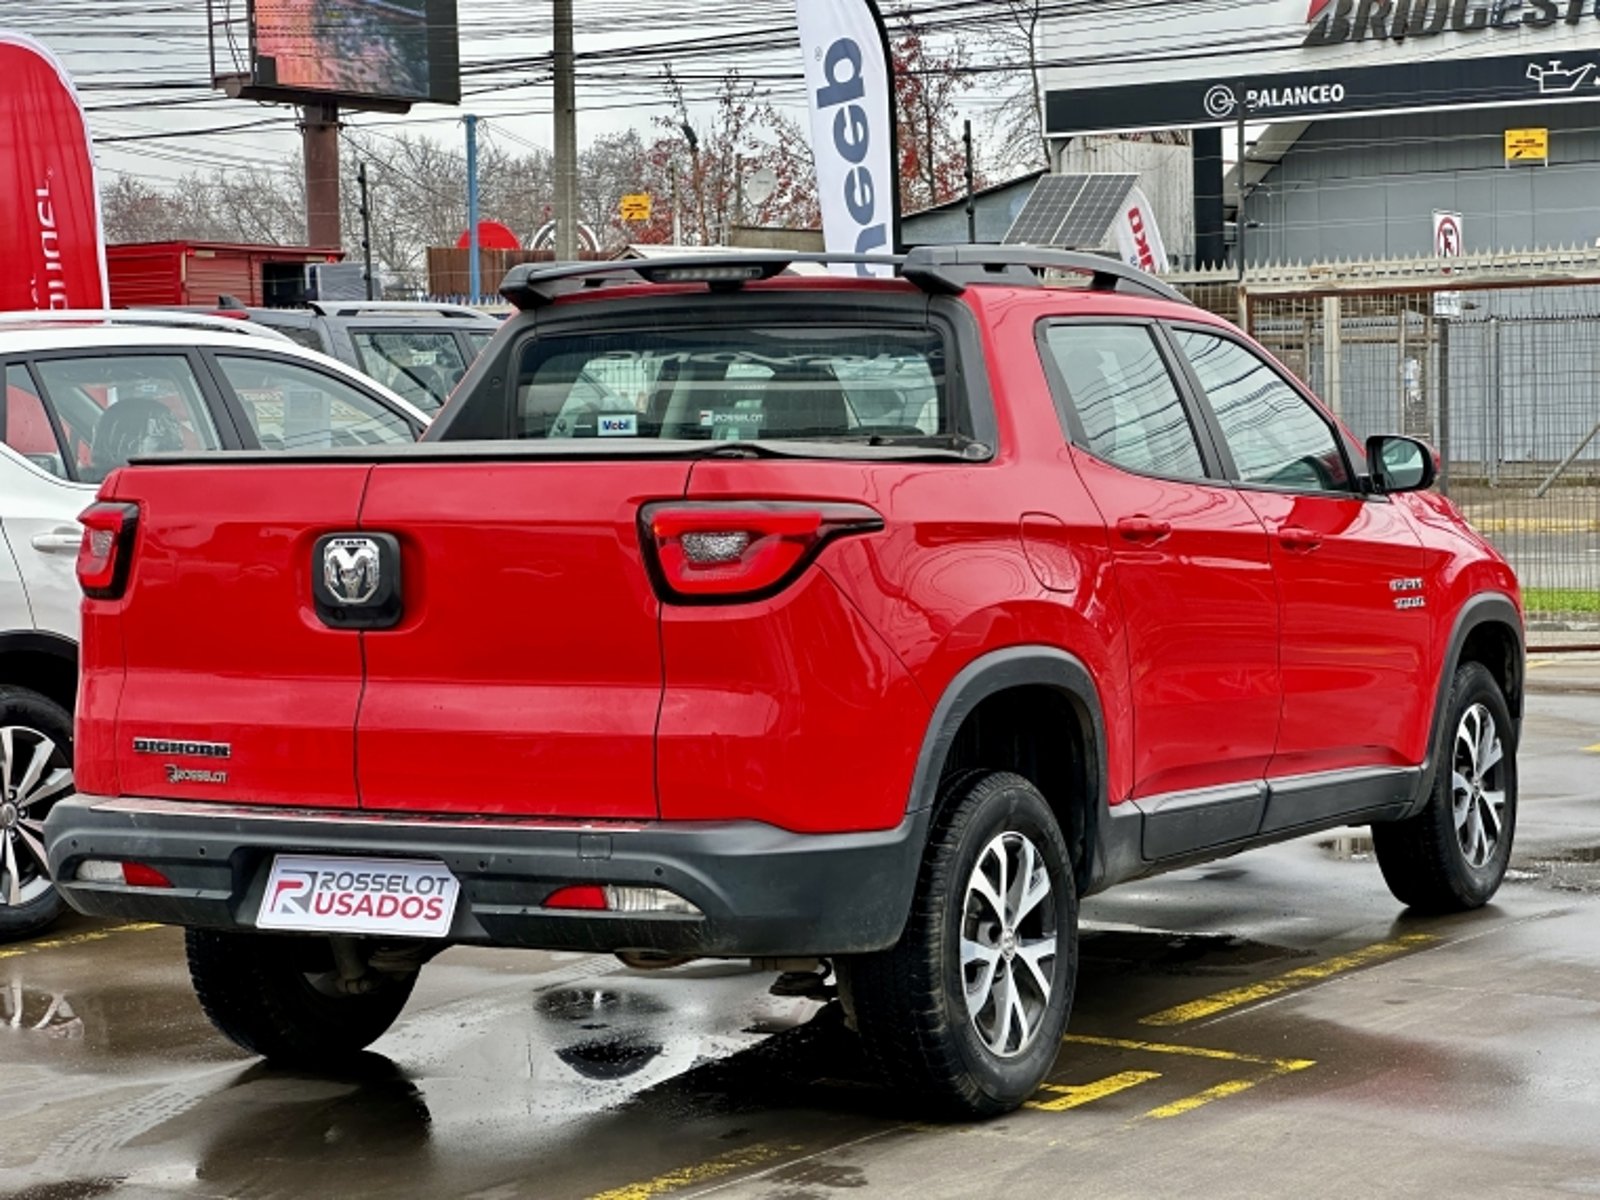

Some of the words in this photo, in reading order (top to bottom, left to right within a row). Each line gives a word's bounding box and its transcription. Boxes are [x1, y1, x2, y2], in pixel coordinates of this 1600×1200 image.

[1246, 83, 1345, 108] BALANCEO
[602, 420, 632, 431] Mobil
[133, 737, 231, 758] BIGHORN
[319, 871, 450, 896] ROSSELOT
[314, 892, 444, 921] USADOS
